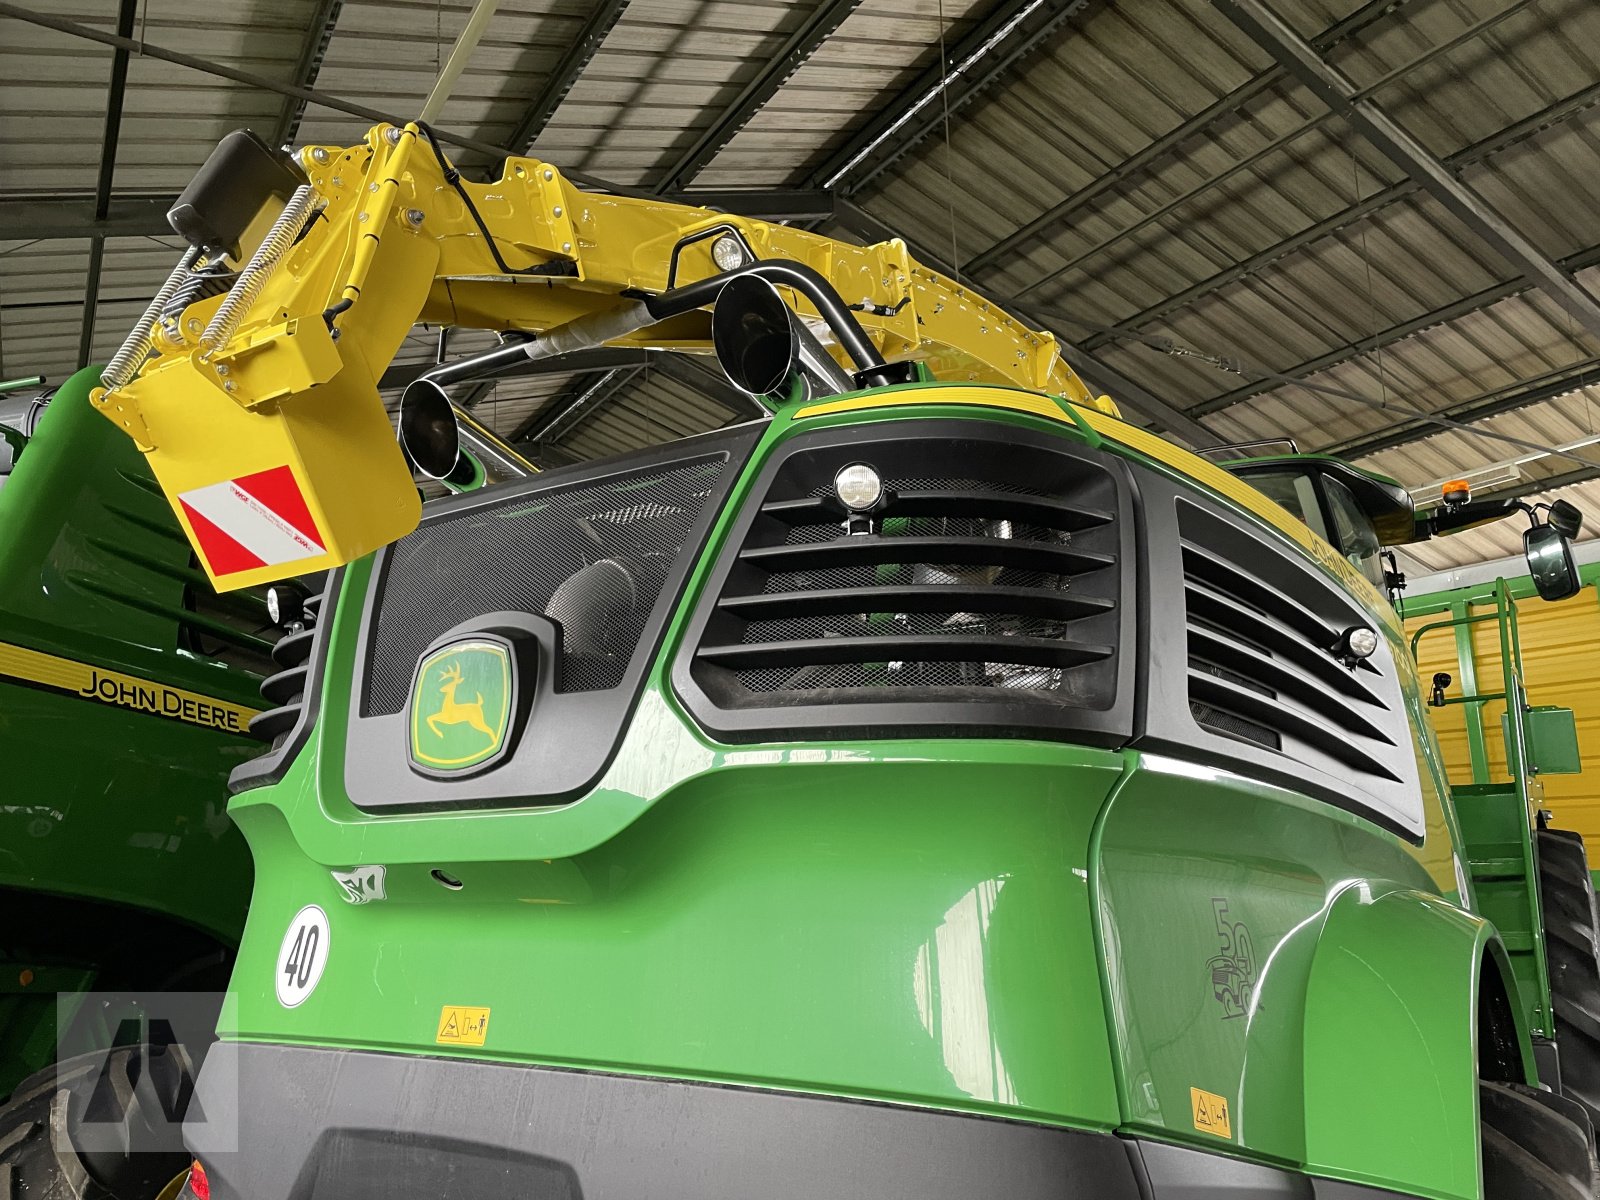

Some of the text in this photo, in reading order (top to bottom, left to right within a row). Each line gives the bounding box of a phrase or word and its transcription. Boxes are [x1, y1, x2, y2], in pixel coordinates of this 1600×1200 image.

[82, 671, 240, 730] JOHN DEERE
[284, 924, 320, 989] 40
